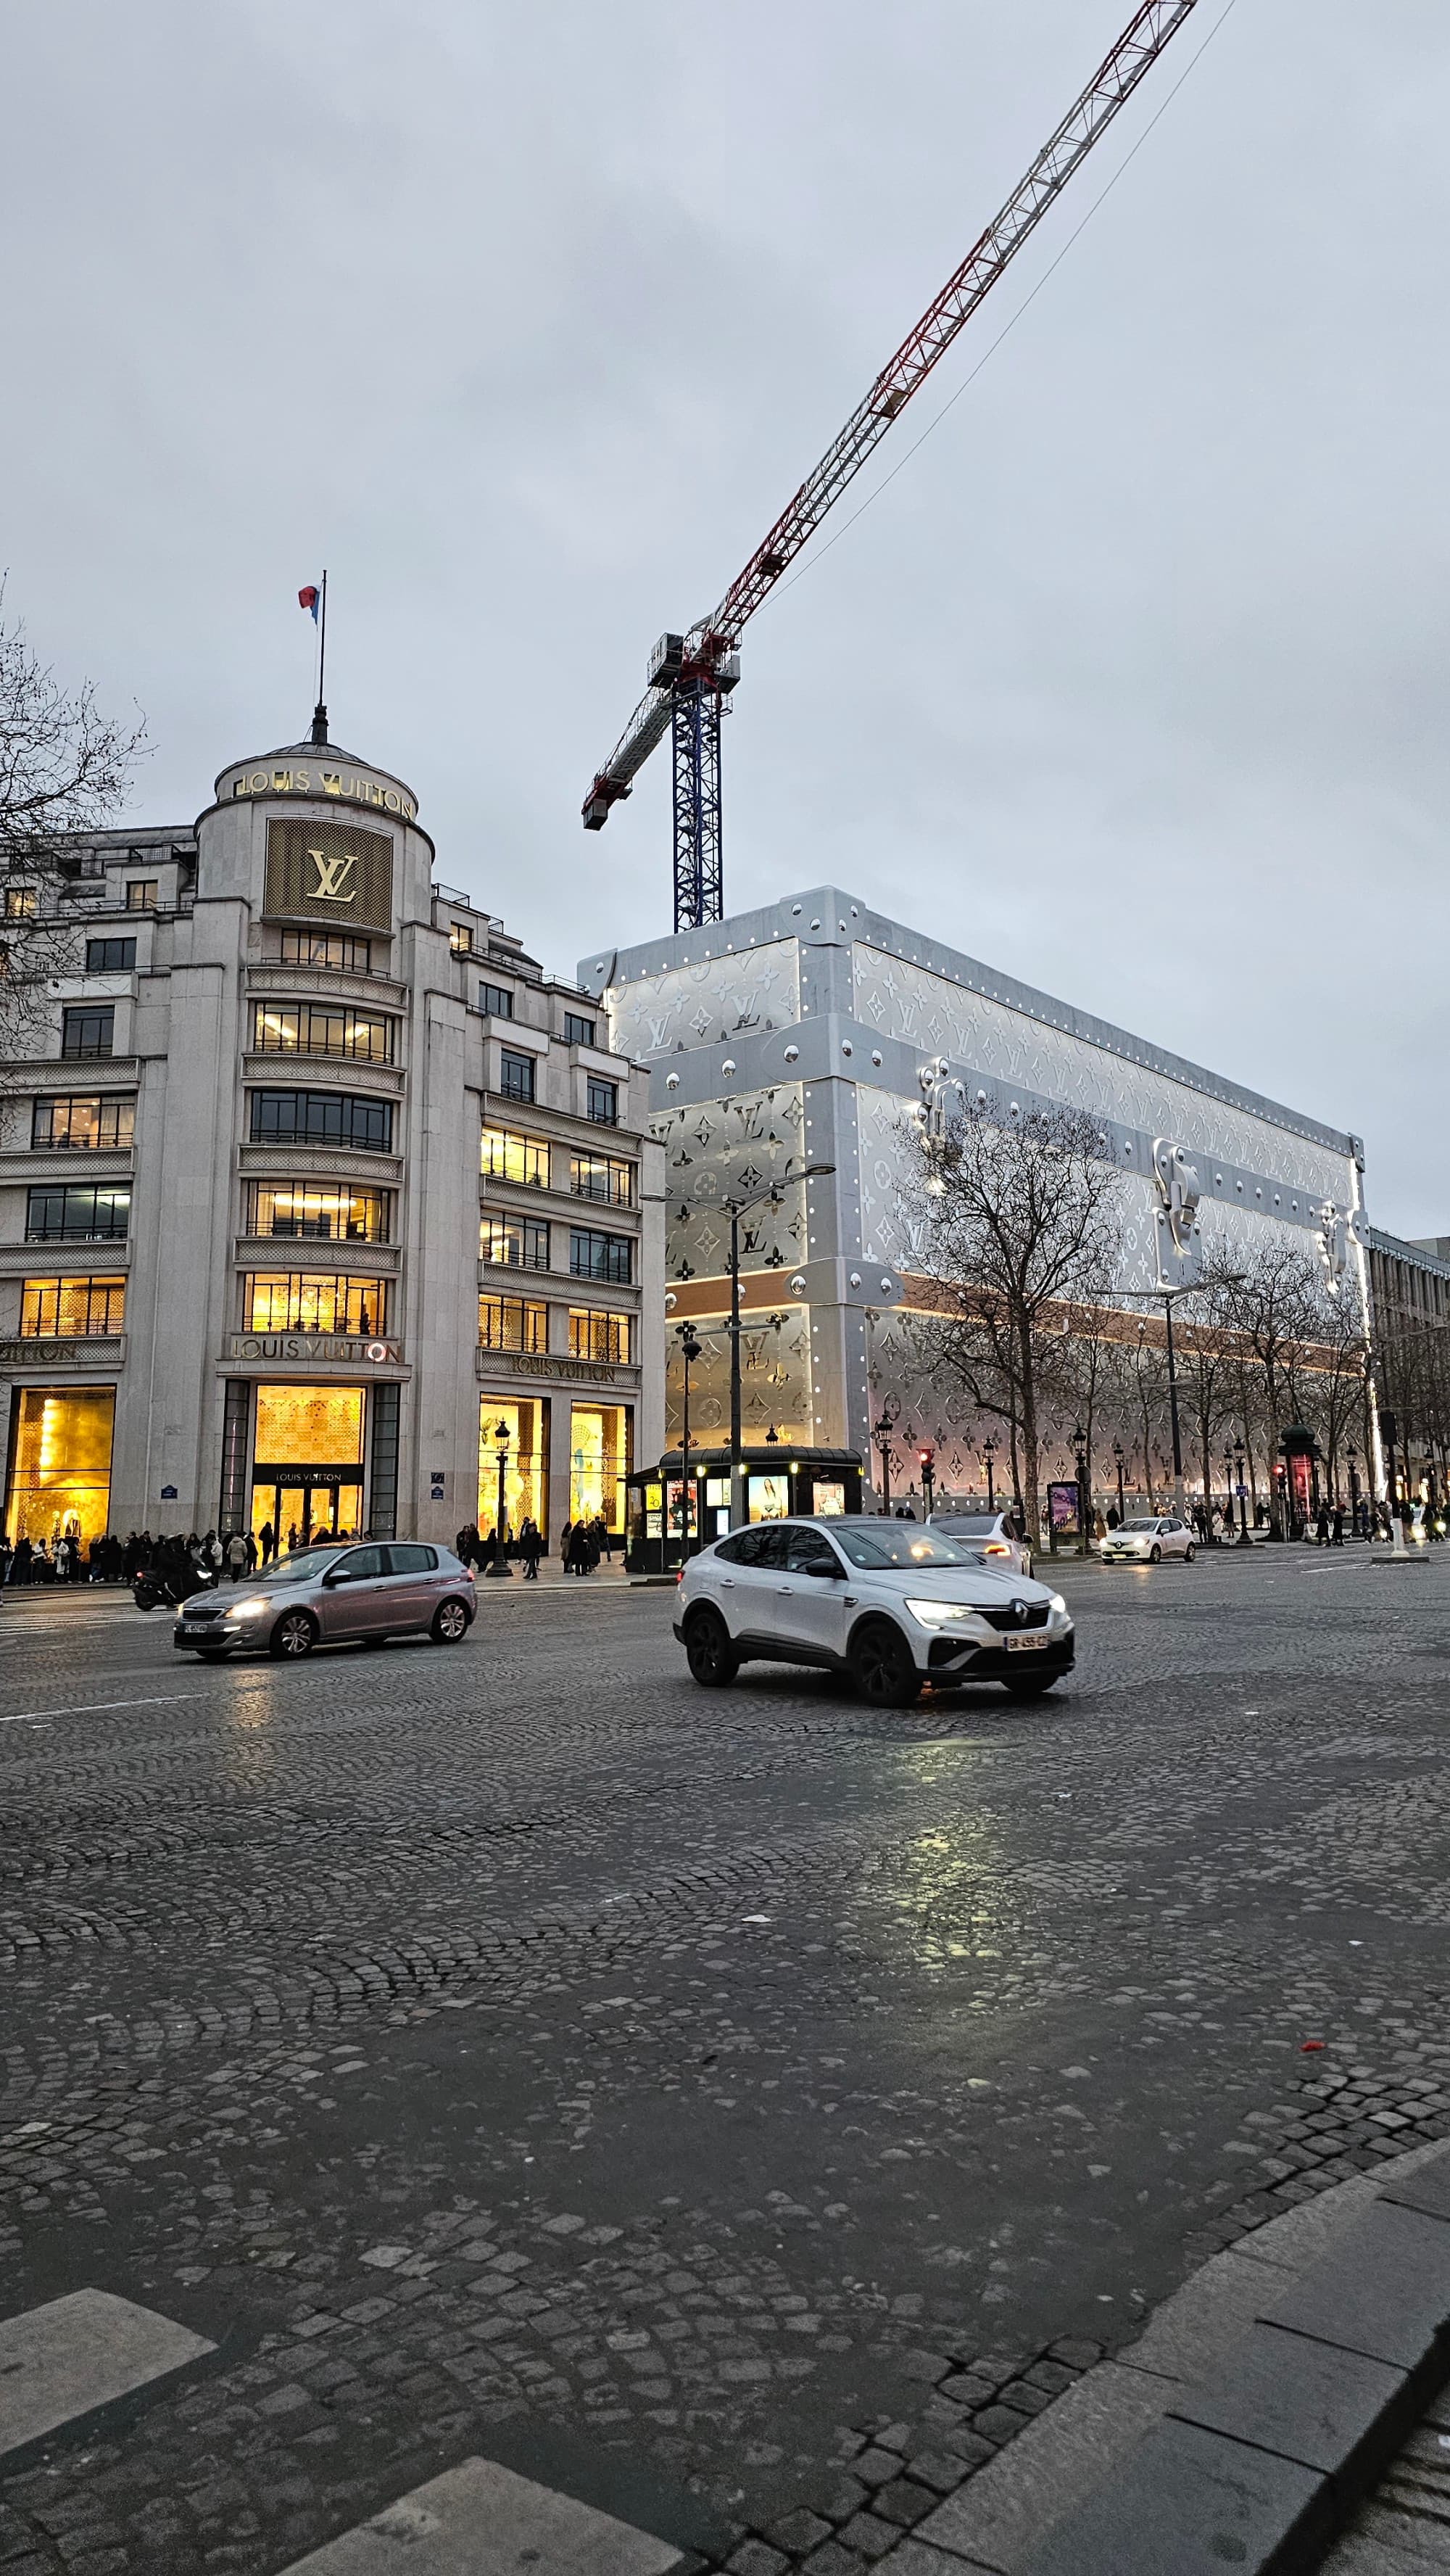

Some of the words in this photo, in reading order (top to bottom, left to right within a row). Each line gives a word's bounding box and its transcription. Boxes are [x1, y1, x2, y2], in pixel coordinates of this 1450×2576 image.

[241, 770, 311, 793] LOUIS
[318, 772, 413, 820] VUITTON
[307, 849, 359, 902] LV
[233, 1339, 299, 1358] LOUIS
[306, 1340, 402, 1363] VUITTON
[513, 1357, 553, 1376] LOUIS
[558, 1361, 615, 1383] VUITTON
